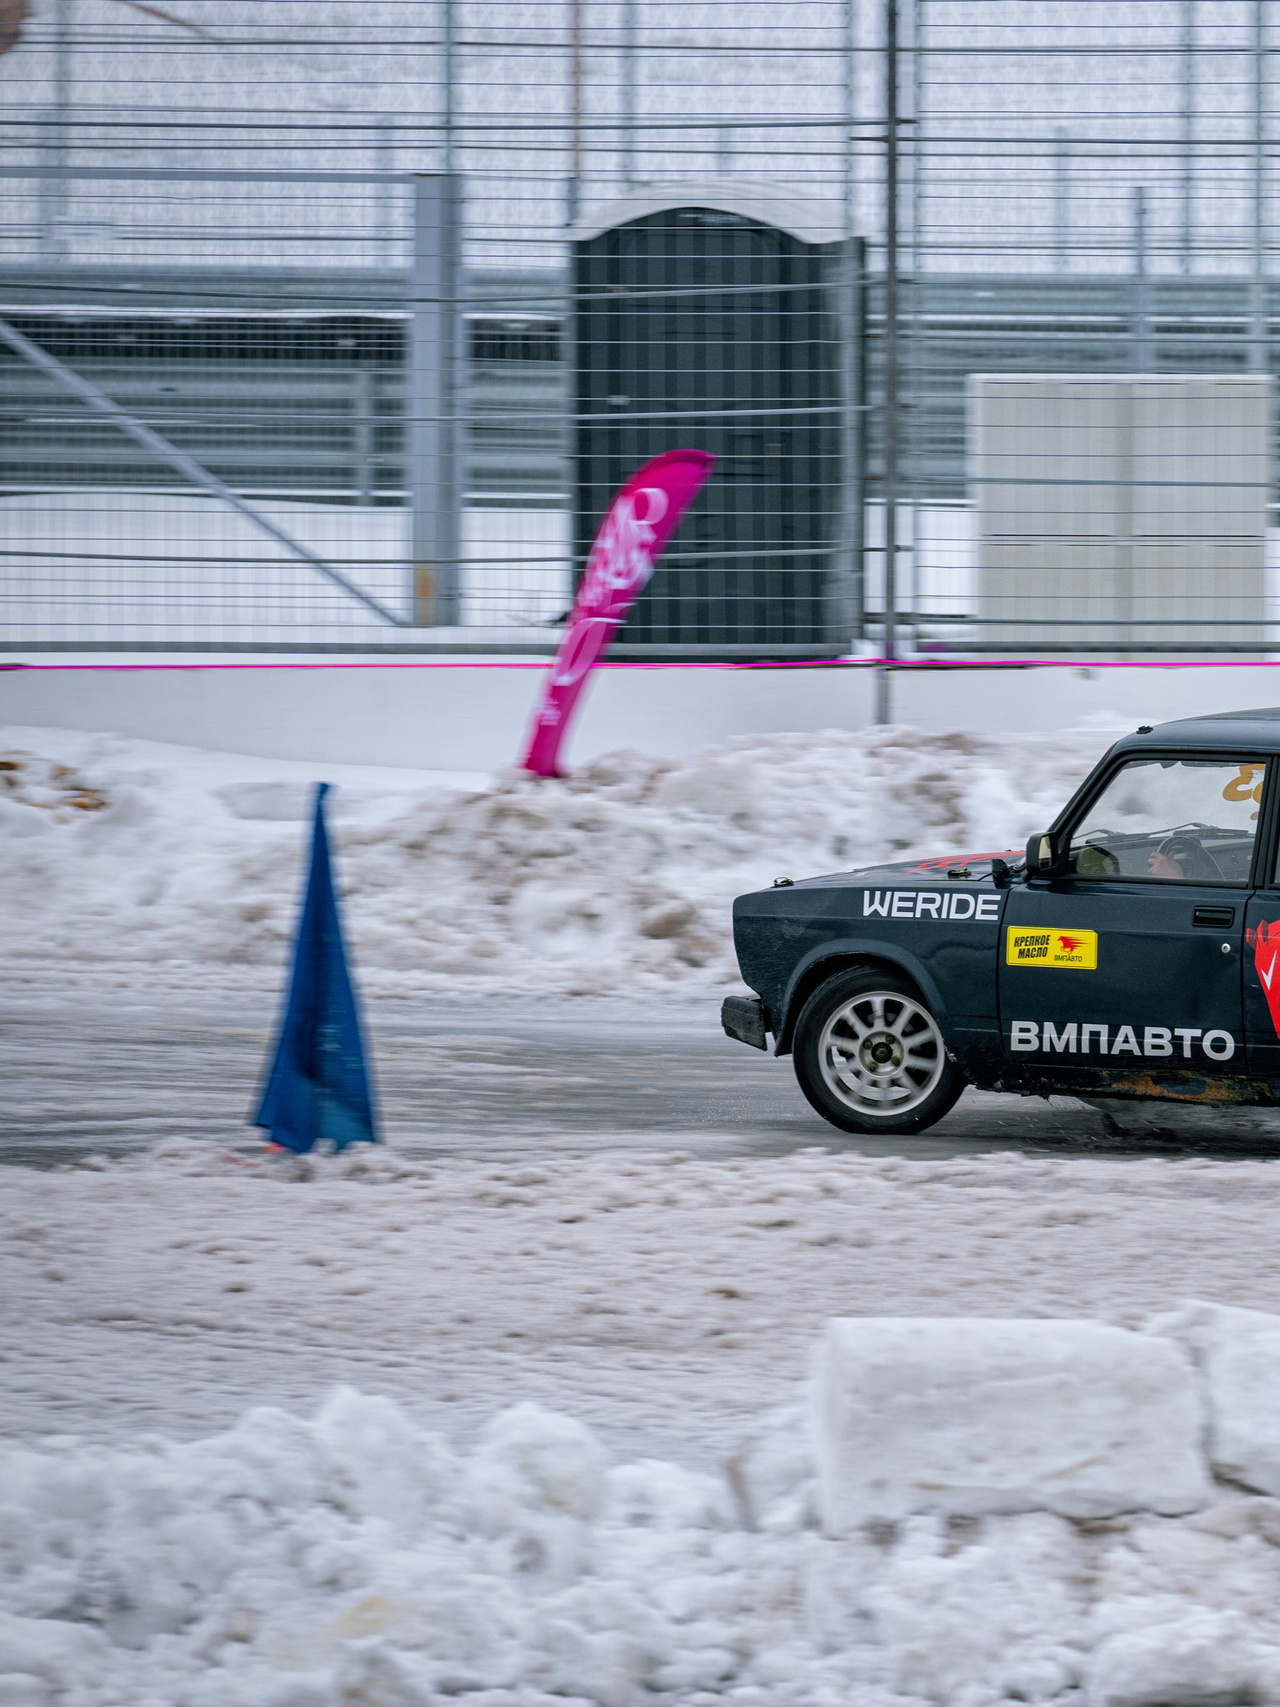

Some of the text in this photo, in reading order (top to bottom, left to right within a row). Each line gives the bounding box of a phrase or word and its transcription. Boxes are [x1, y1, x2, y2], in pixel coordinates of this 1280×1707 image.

[862, 890, 1001, 921] WERIDE
[1013, 934, 1051, 948] КРЕПКОЕ
[1017, 946, 1048, 959] МАСЛО
[1053, 954, 1083, 963] ВМПАВТО
[1010, 1020, 1236, 1061] ВМПАВТО
